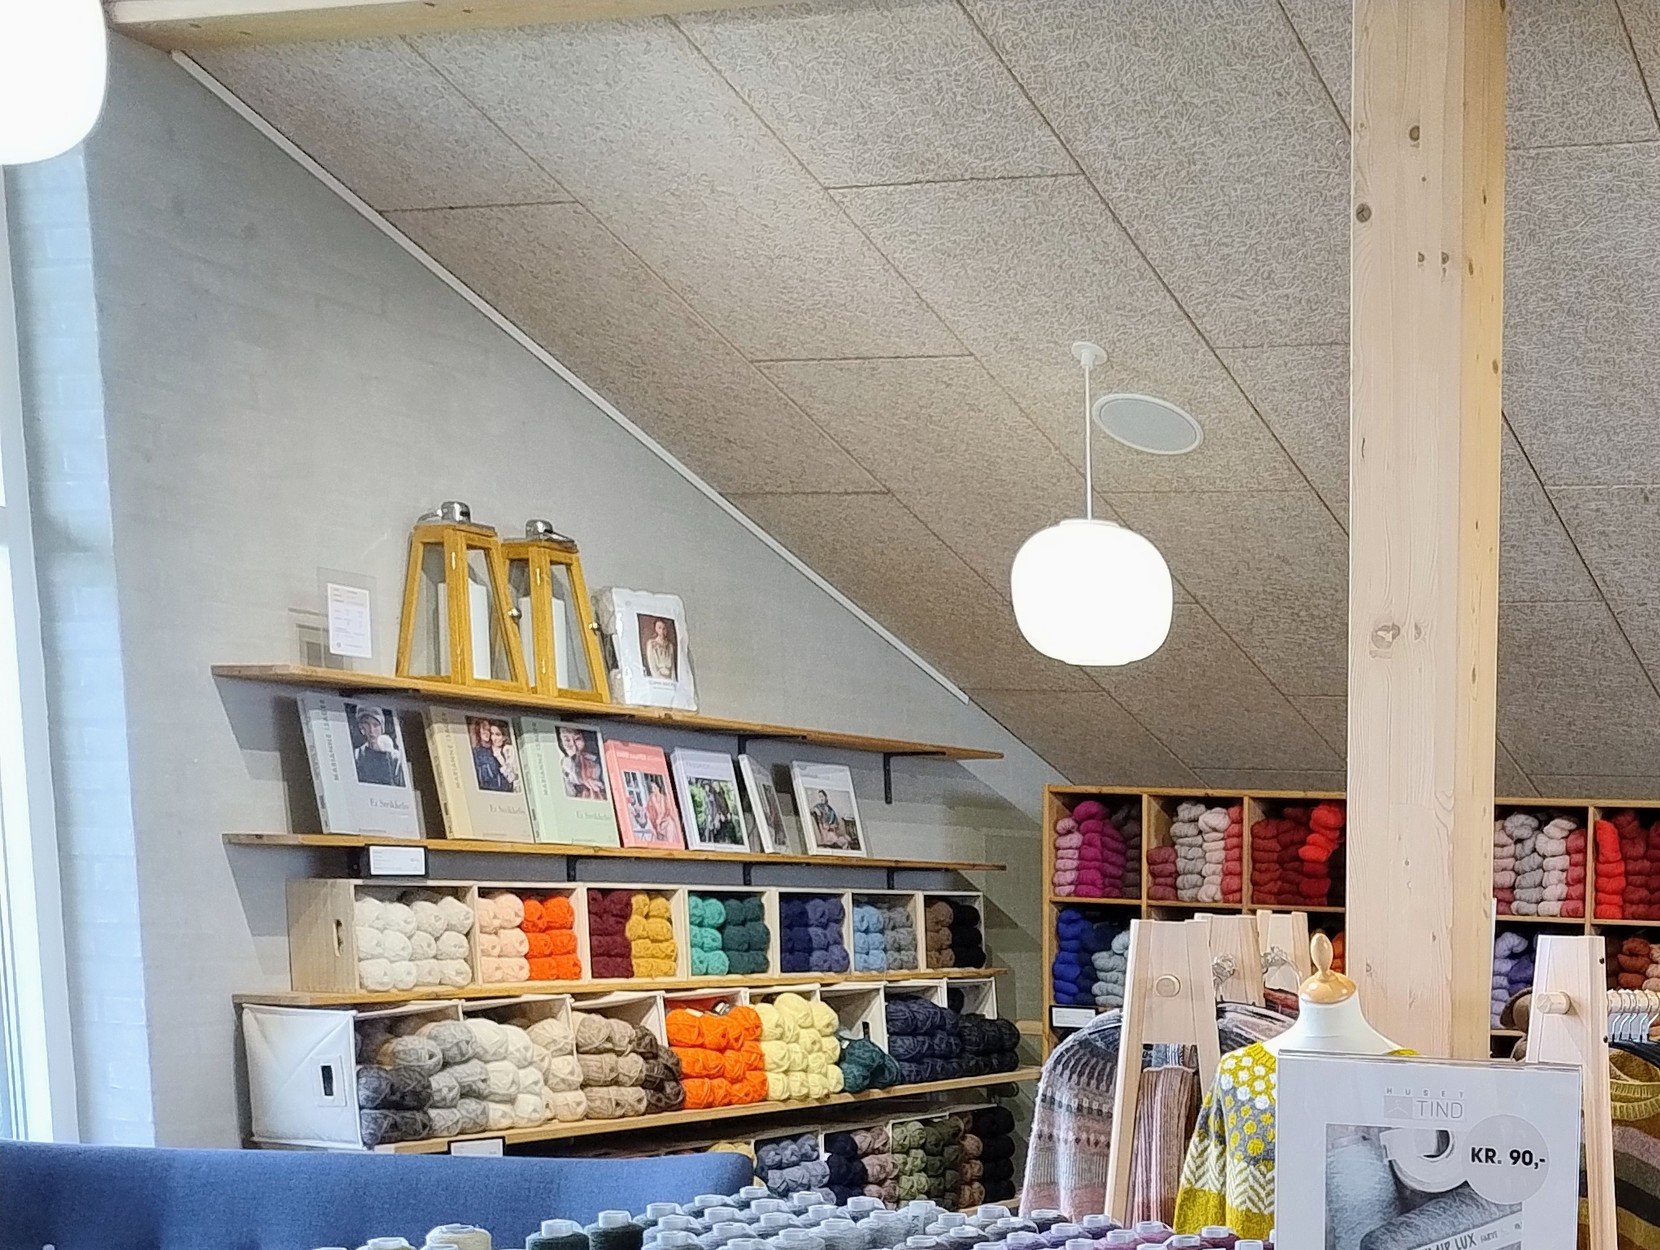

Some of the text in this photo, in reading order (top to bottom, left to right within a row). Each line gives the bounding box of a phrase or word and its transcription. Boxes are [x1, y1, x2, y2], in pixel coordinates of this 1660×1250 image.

[1386, 1088, 1464, 1098] HUSET
[1416, 1100, 1463, 1119] TIND
[1471, 1147, 1546, 1170] KR. 90,-
